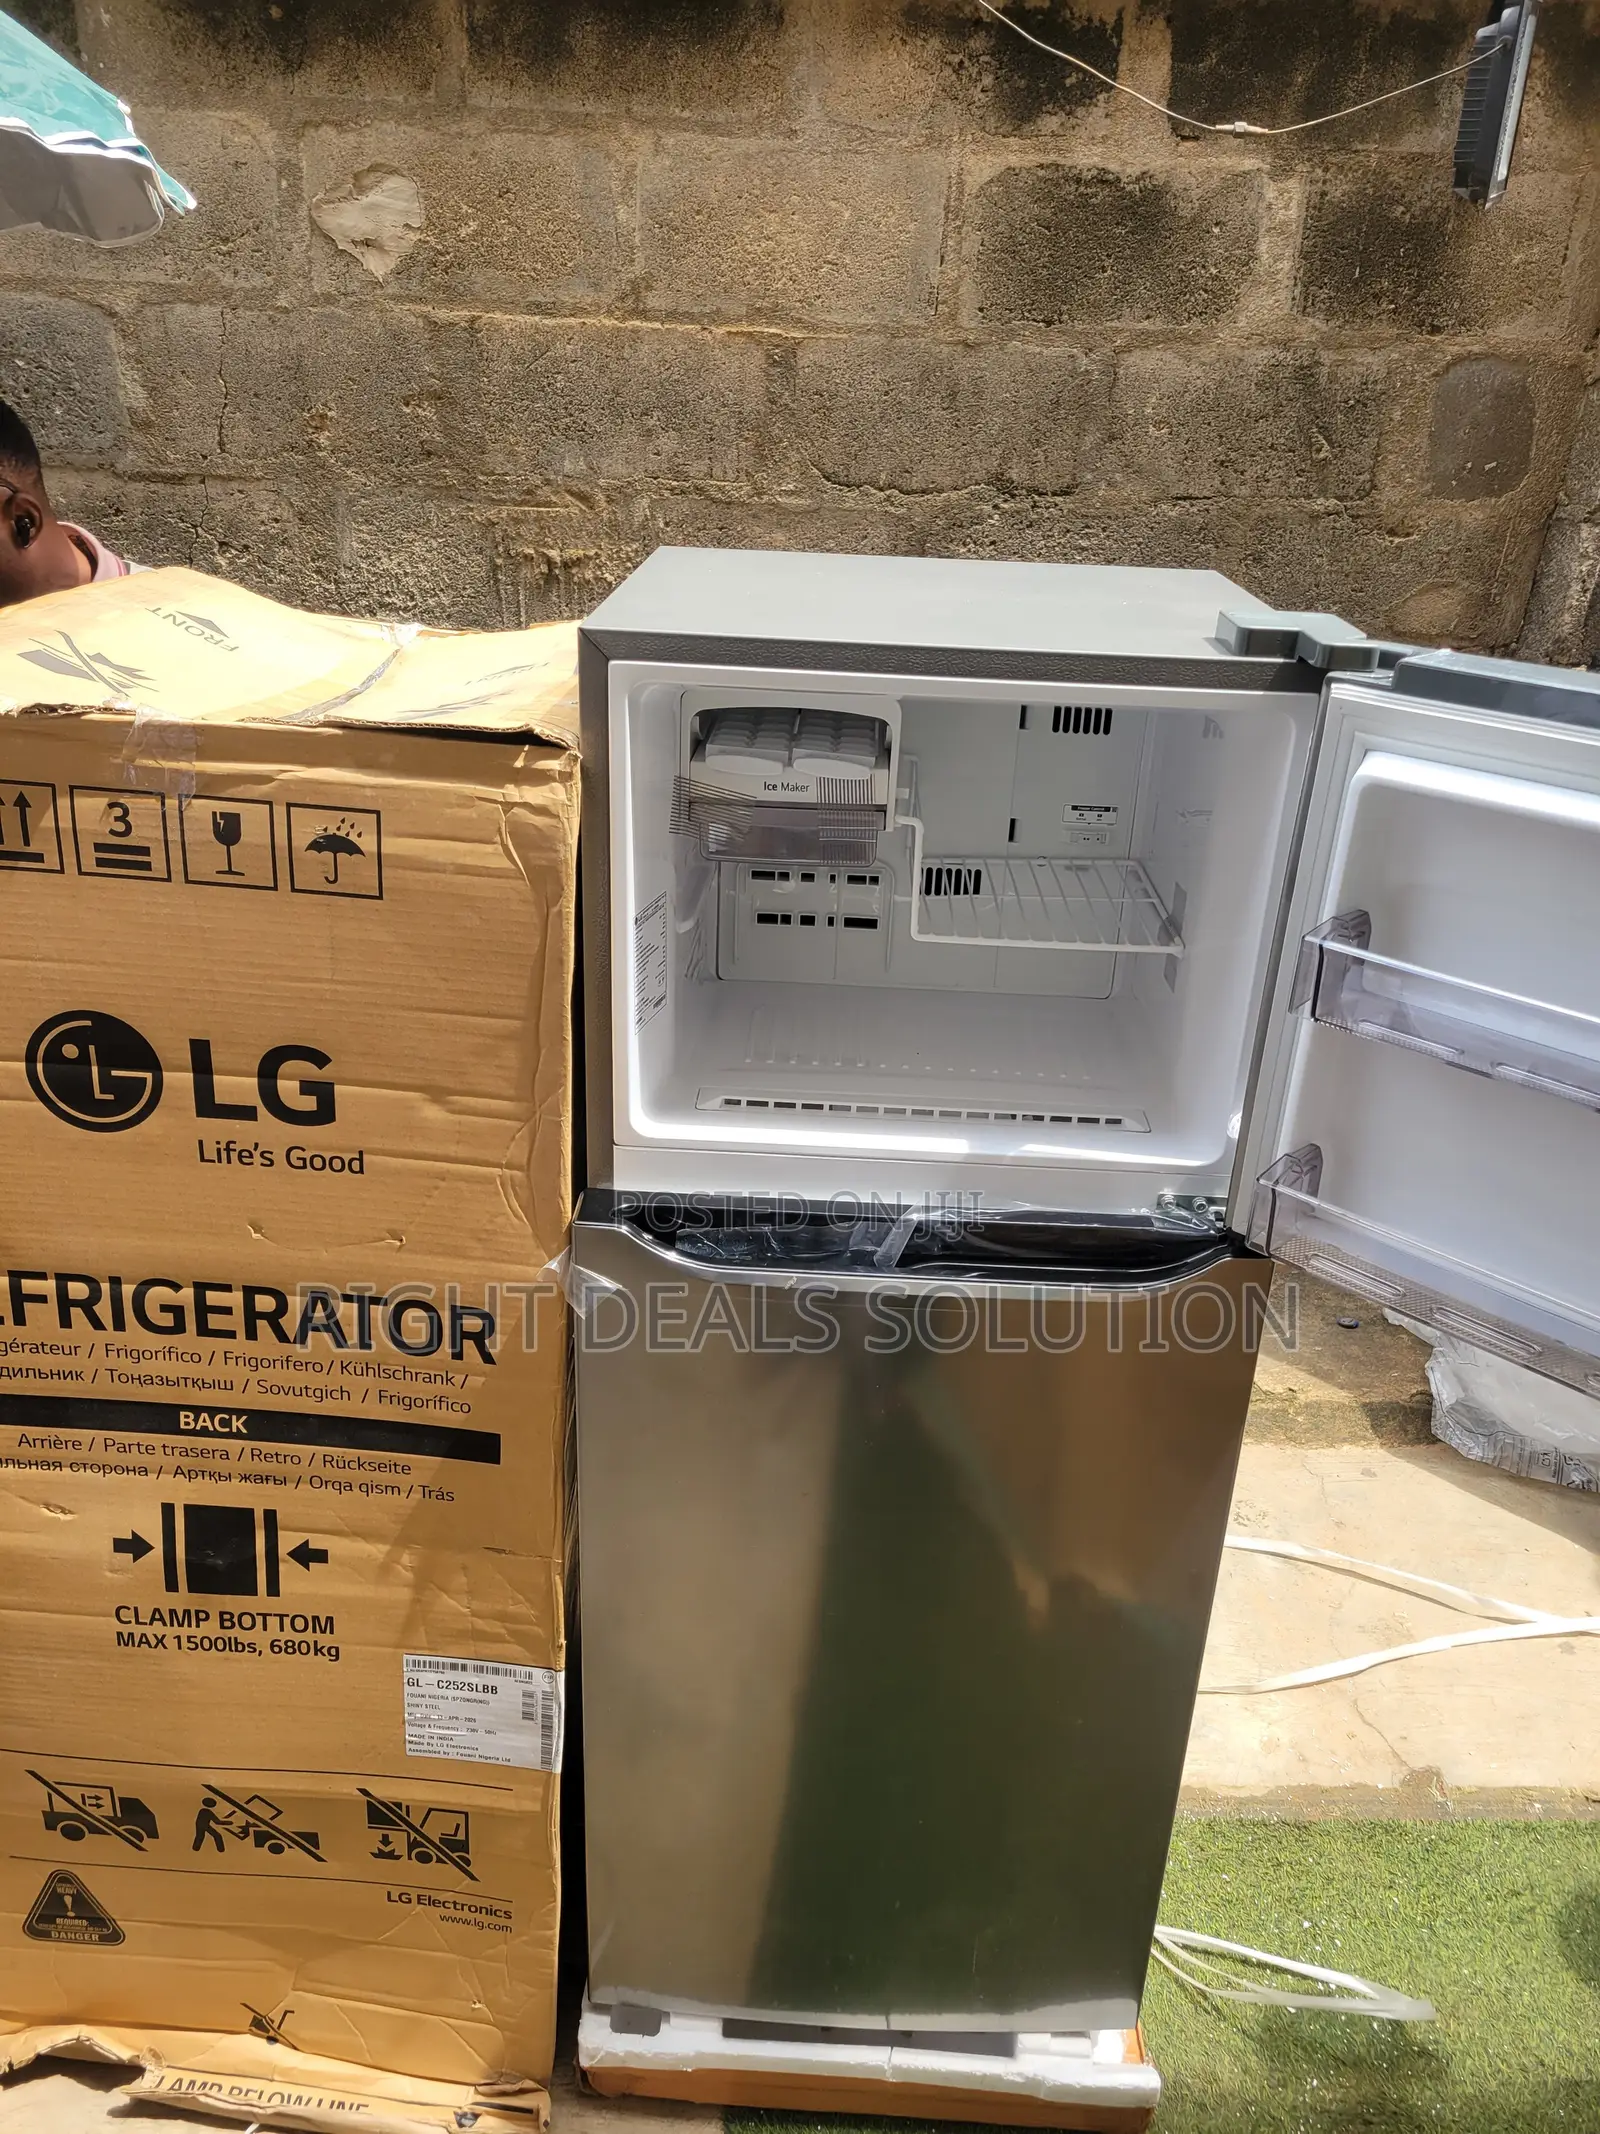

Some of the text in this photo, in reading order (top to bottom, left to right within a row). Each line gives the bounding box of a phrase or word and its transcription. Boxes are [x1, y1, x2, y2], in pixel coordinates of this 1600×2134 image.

[144, 607, 240, 652] FRONT
[763, 781, 810, 793] Ice Maker
[107, 801, 132, 838] 3
[188, 1038, 337, 1127] LG
[198, 1139, 365, 1176] Life's Good
[0, 1270, 497, 1366] FRIGERATOR
[104, 1343, 202, 1365] Frigorífico
[223, 1351, 325, 1375] Frigorifero
[340, 1360, 455, 1387] Kühlschrank
[257, 1379, 352, 1403] Sovutgich
[378, 1390, 472, 1415] Frigorífico
[179, 1411, 248, 1434] BACK
[18, 1433, 82, 1451] Arrière
[104, 1438, 156, 1456] Parte
[162, 1442, 230, 1461] trasera
[250, 1448, 301, 1466] Retro
[323, 1453, 412, 1475] Rückseite
[70, 1461, 149, 1478] сторона
[309, 1475, 354, 1496] Orqa
[359, 1478, 401, 1500] qism
[418, 1484, 455, 1502] Trás
[114, 1605, 336, 1635] CLAMP BOTTOM
[116, 1631, 169, 1651] MAX
[173, 1633, 264, 1658] 1500lbs,
[407, 1721, 426, 1729] Voltage
[408, 1747, 441, 1755] Assembled
[456, 1751, 477, 1759] Fouani
[478, 1754, 500, 1762] Nigeria
[386, 1890, 513, 1920] LG Electronics
[51, 1930, 100, 1942] DANGER
[439, 1913, 513, 1934] www.lg.com
